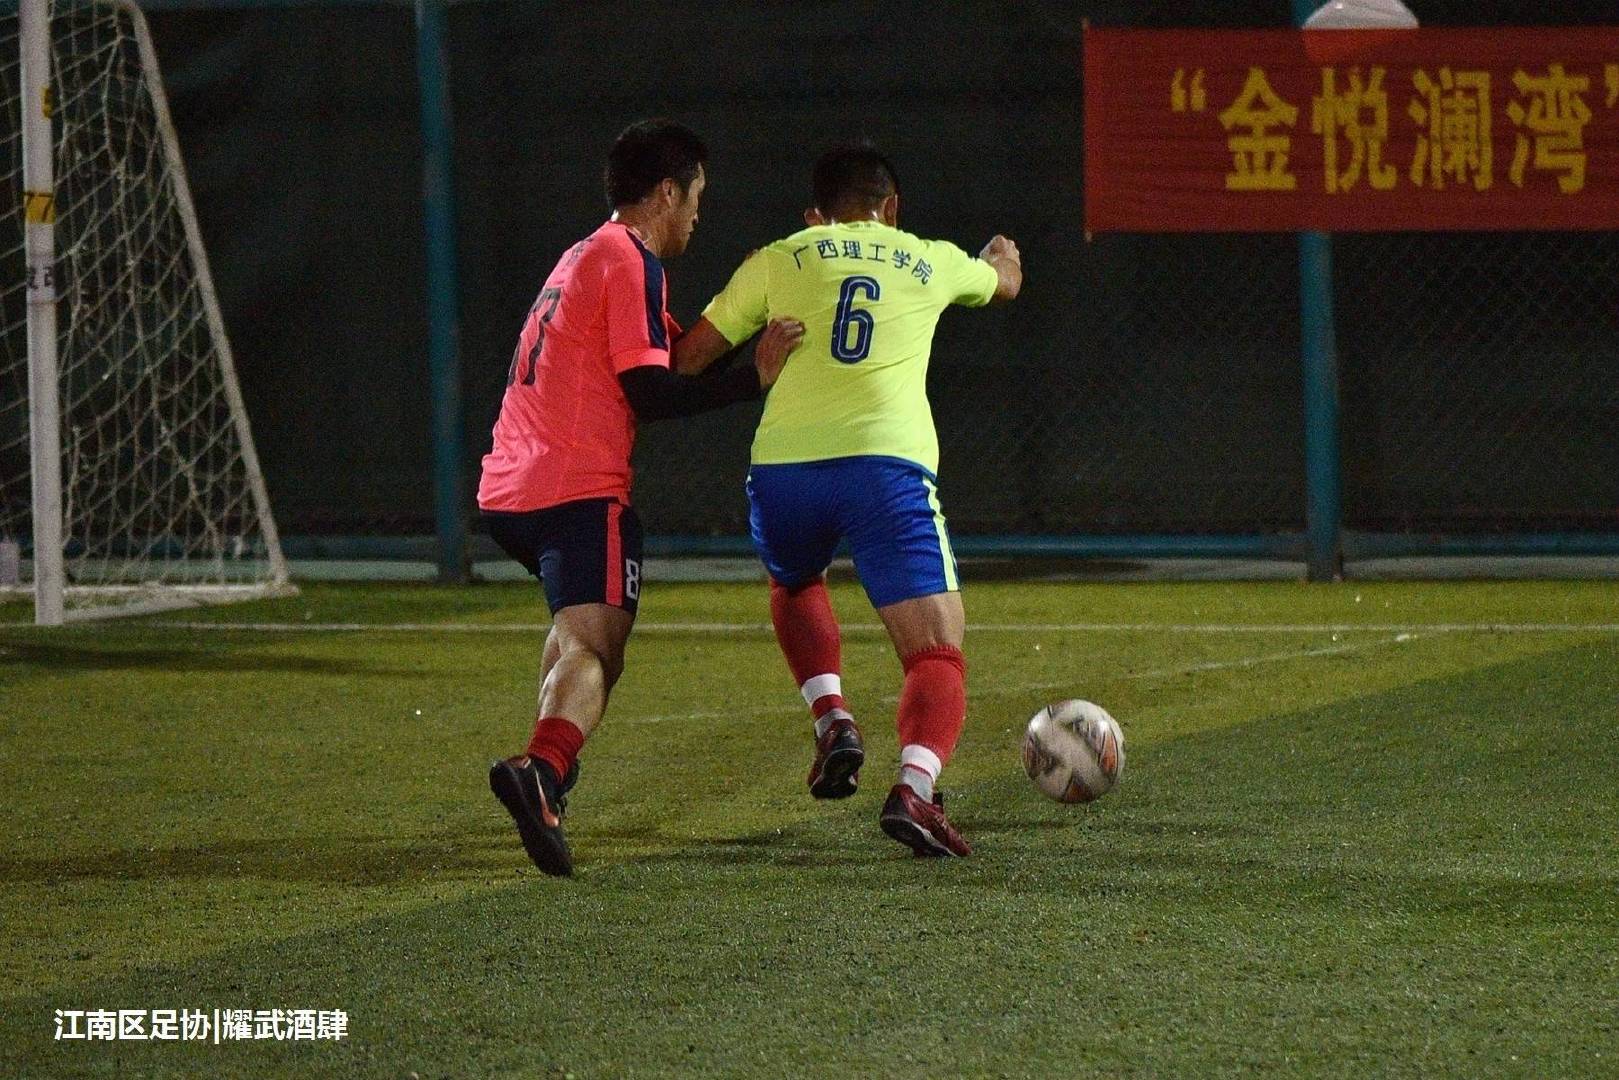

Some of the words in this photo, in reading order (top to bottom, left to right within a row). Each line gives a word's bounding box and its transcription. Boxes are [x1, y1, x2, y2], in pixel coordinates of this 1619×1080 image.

[793, 238, 933, 285] 广西理工学院
[831, 275, 881, 364] 6
